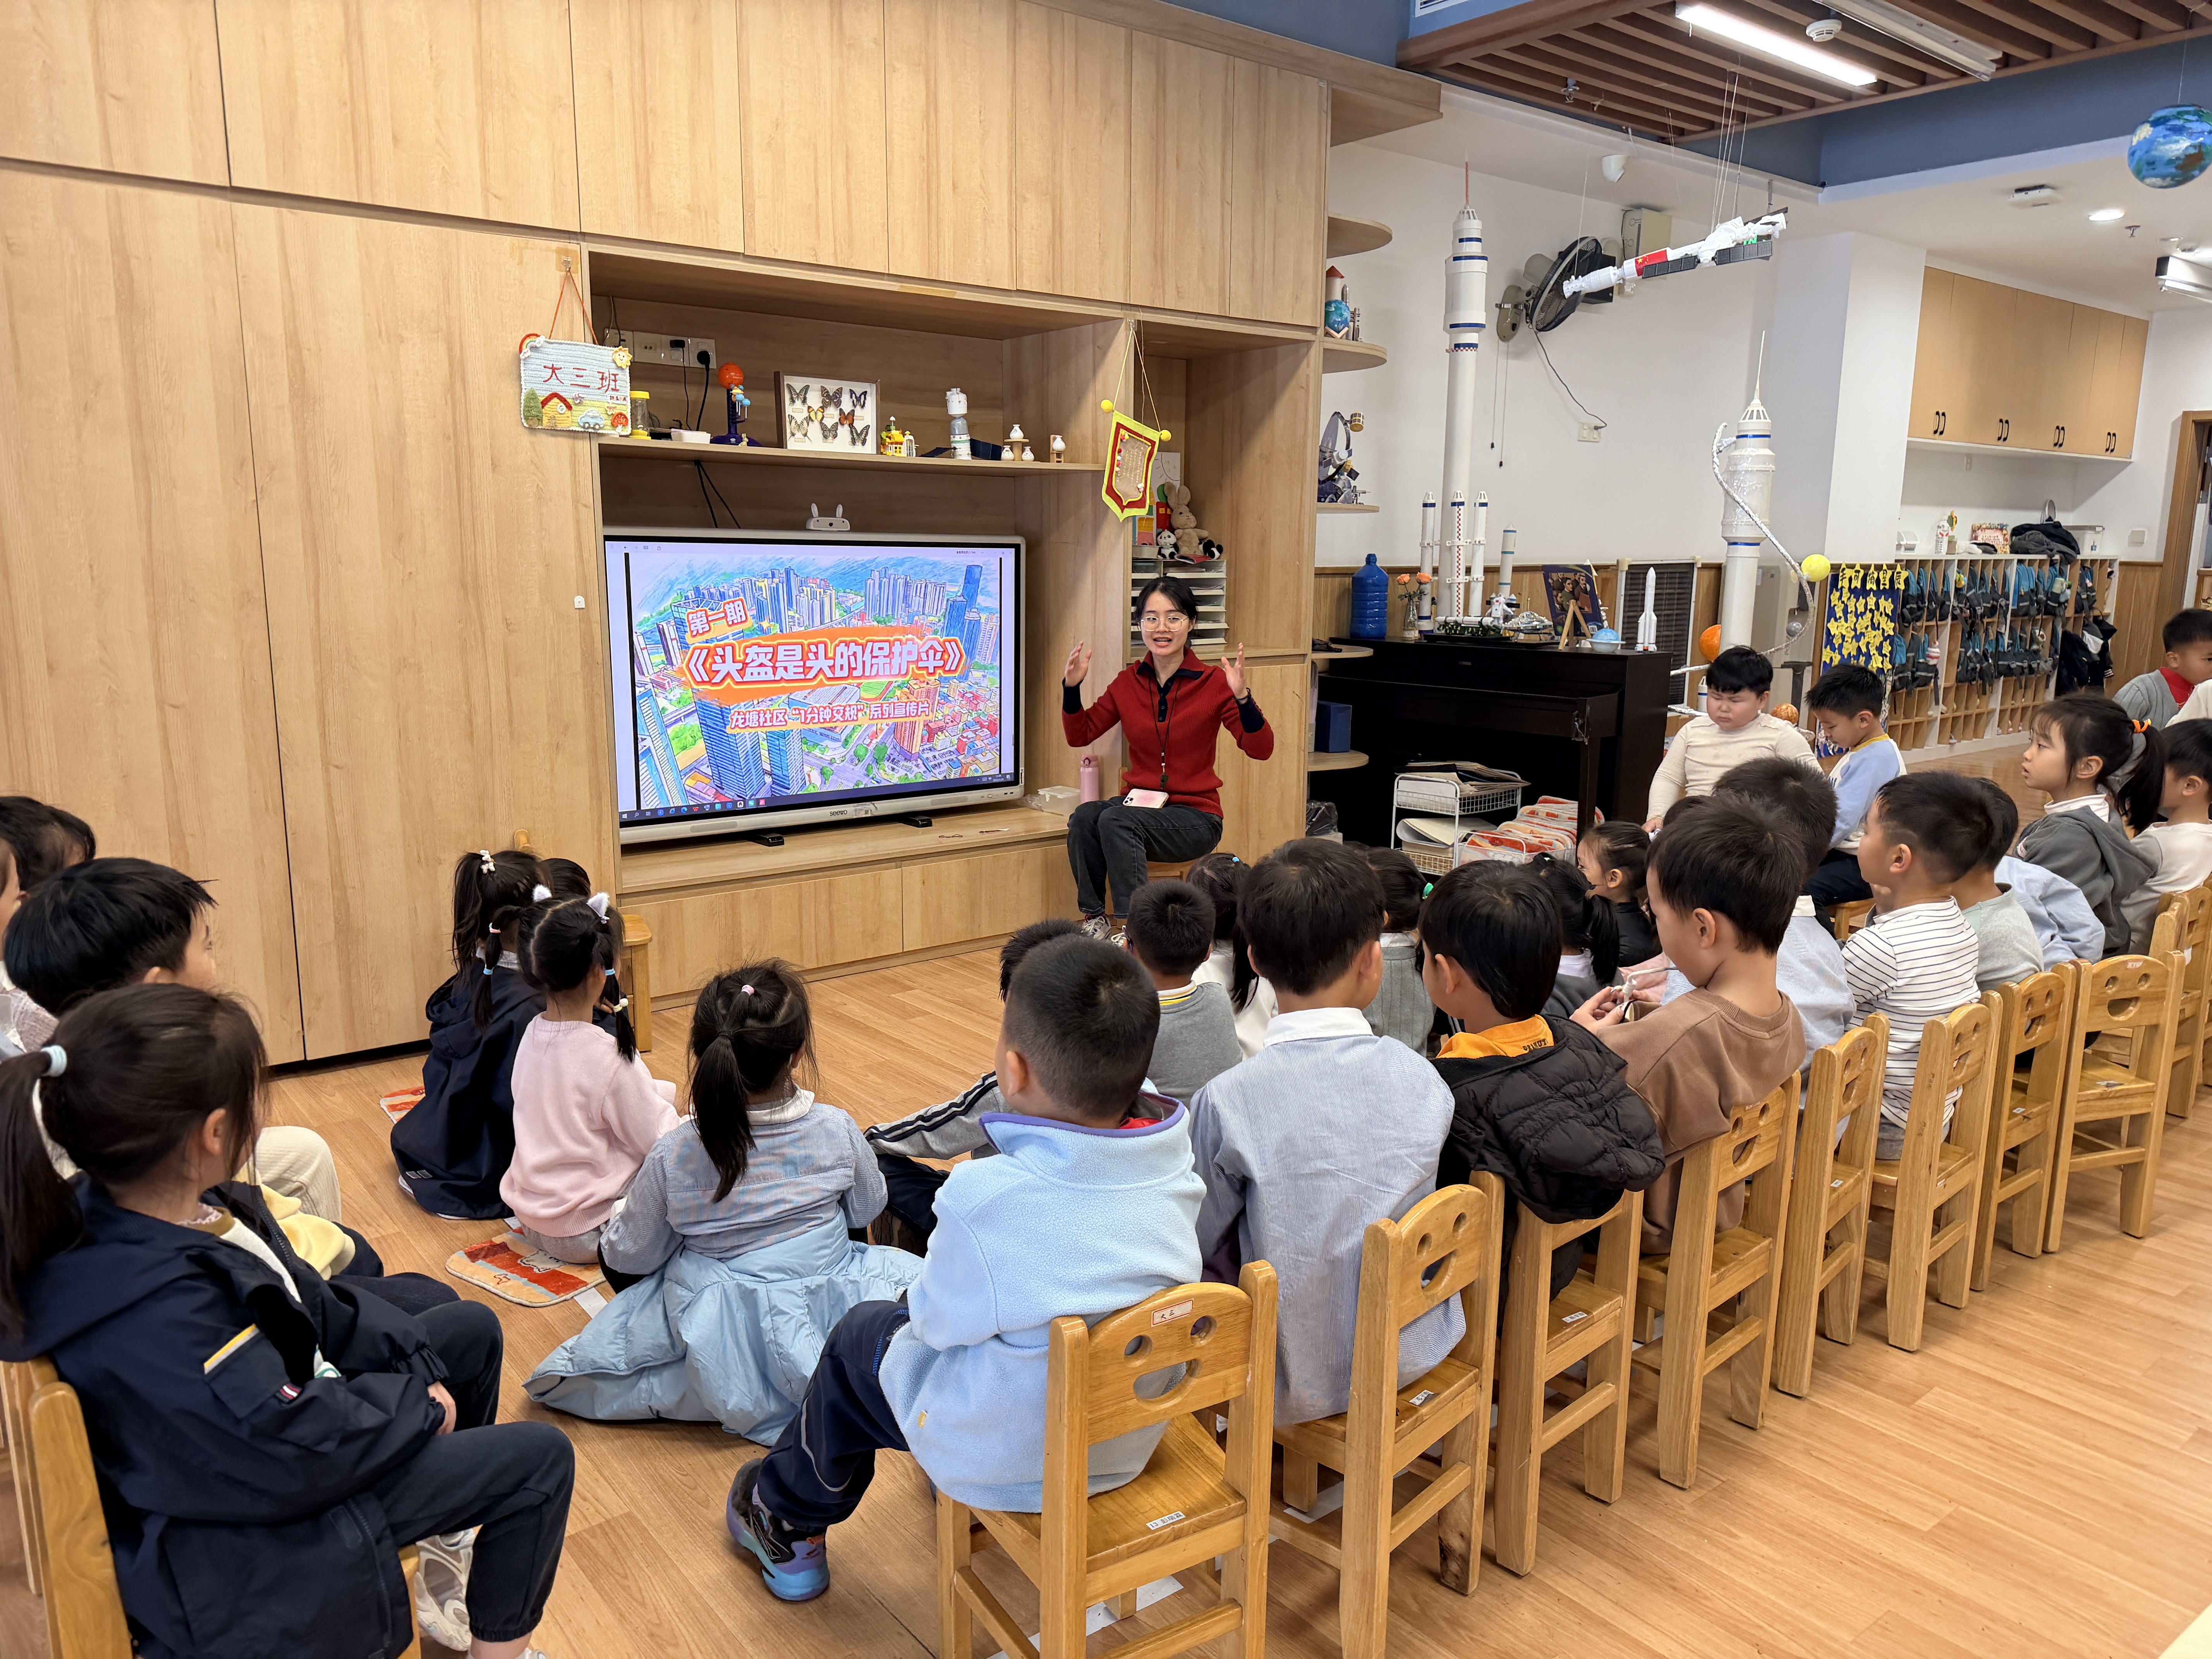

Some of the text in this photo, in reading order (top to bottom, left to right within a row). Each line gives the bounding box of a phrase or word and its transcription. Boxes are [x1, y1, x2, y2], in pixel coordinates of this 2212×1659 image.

[543, 363, 620, 393] 大三班
[1839, 567, 1901, 586] 手可摘星辰
[689, 601, 746, 636] 第一期
[689, 641, 961, 683] 《头盔是头的保护伞》
[1161, 1310, 1175, 1319] 大三
